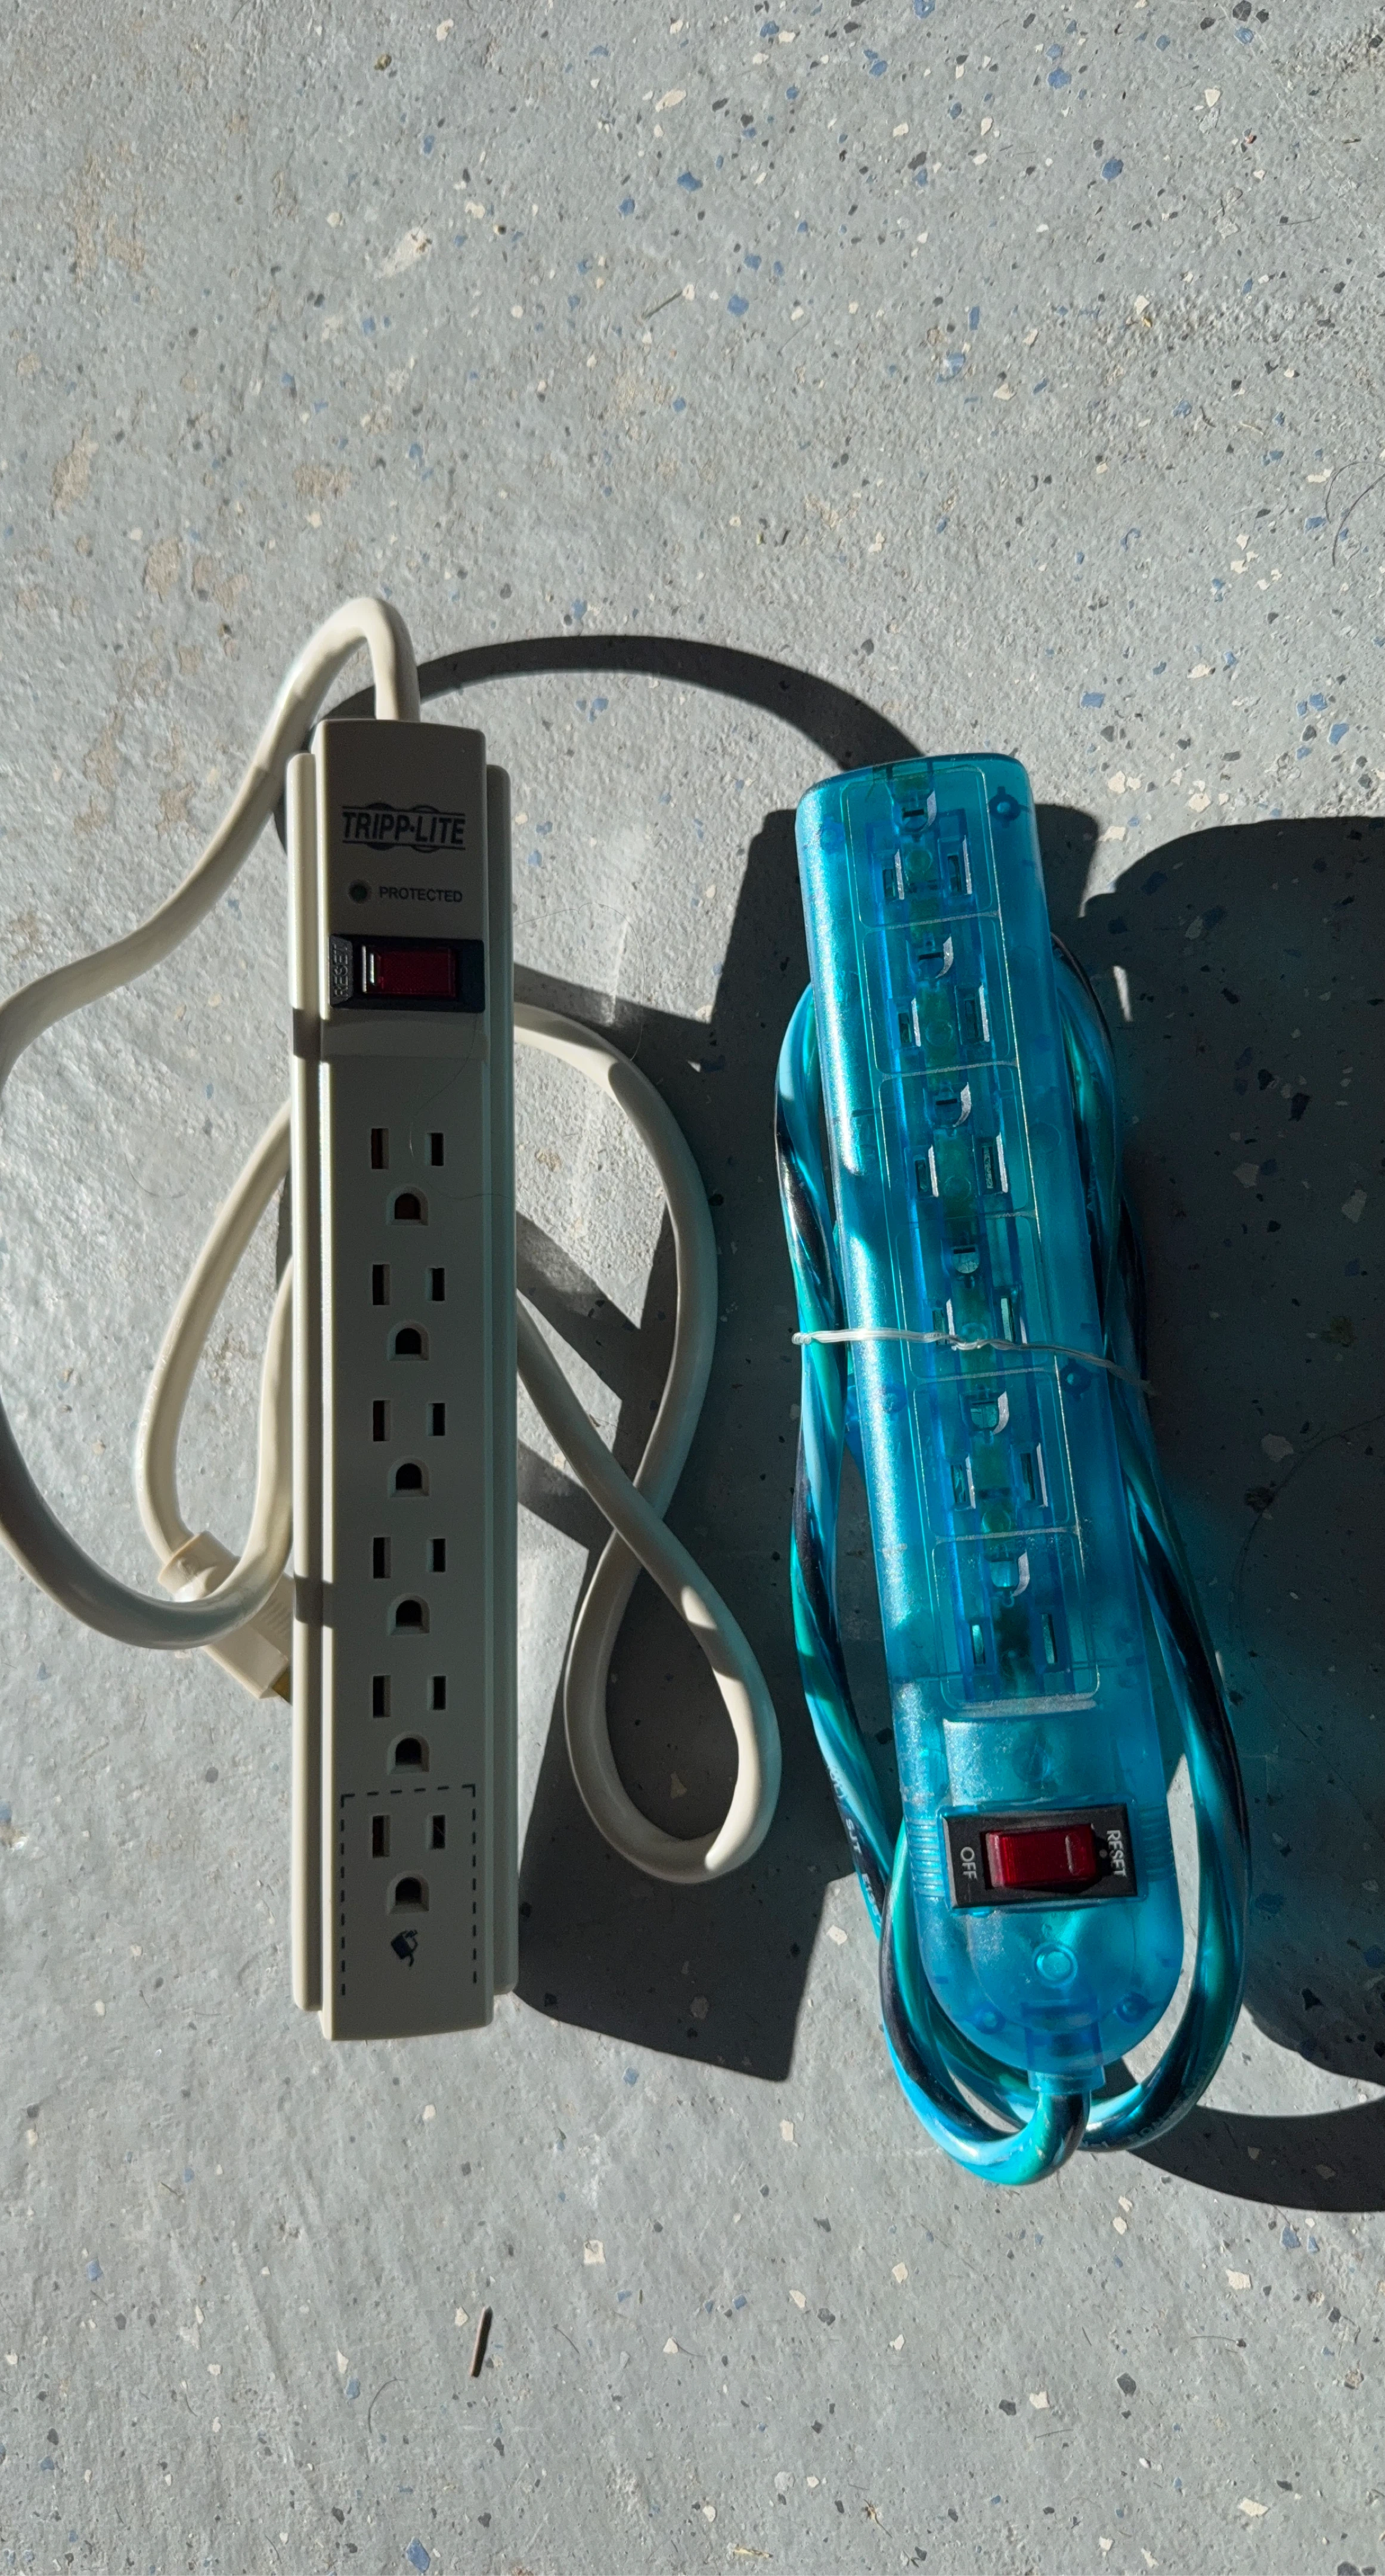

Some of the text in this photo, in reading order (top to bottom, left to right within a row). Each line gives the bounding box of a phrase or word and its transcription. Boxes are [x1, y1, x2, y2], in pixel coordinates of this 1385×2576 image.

[379, 886, 463, 902] PROTECTED
[333, 945, 348, 997] RESET
[846, 1819, 862, 1854] SJT
[1107, 1829, 1126, 1878] RESET
[960, 1847, 977, 1880] OFF
